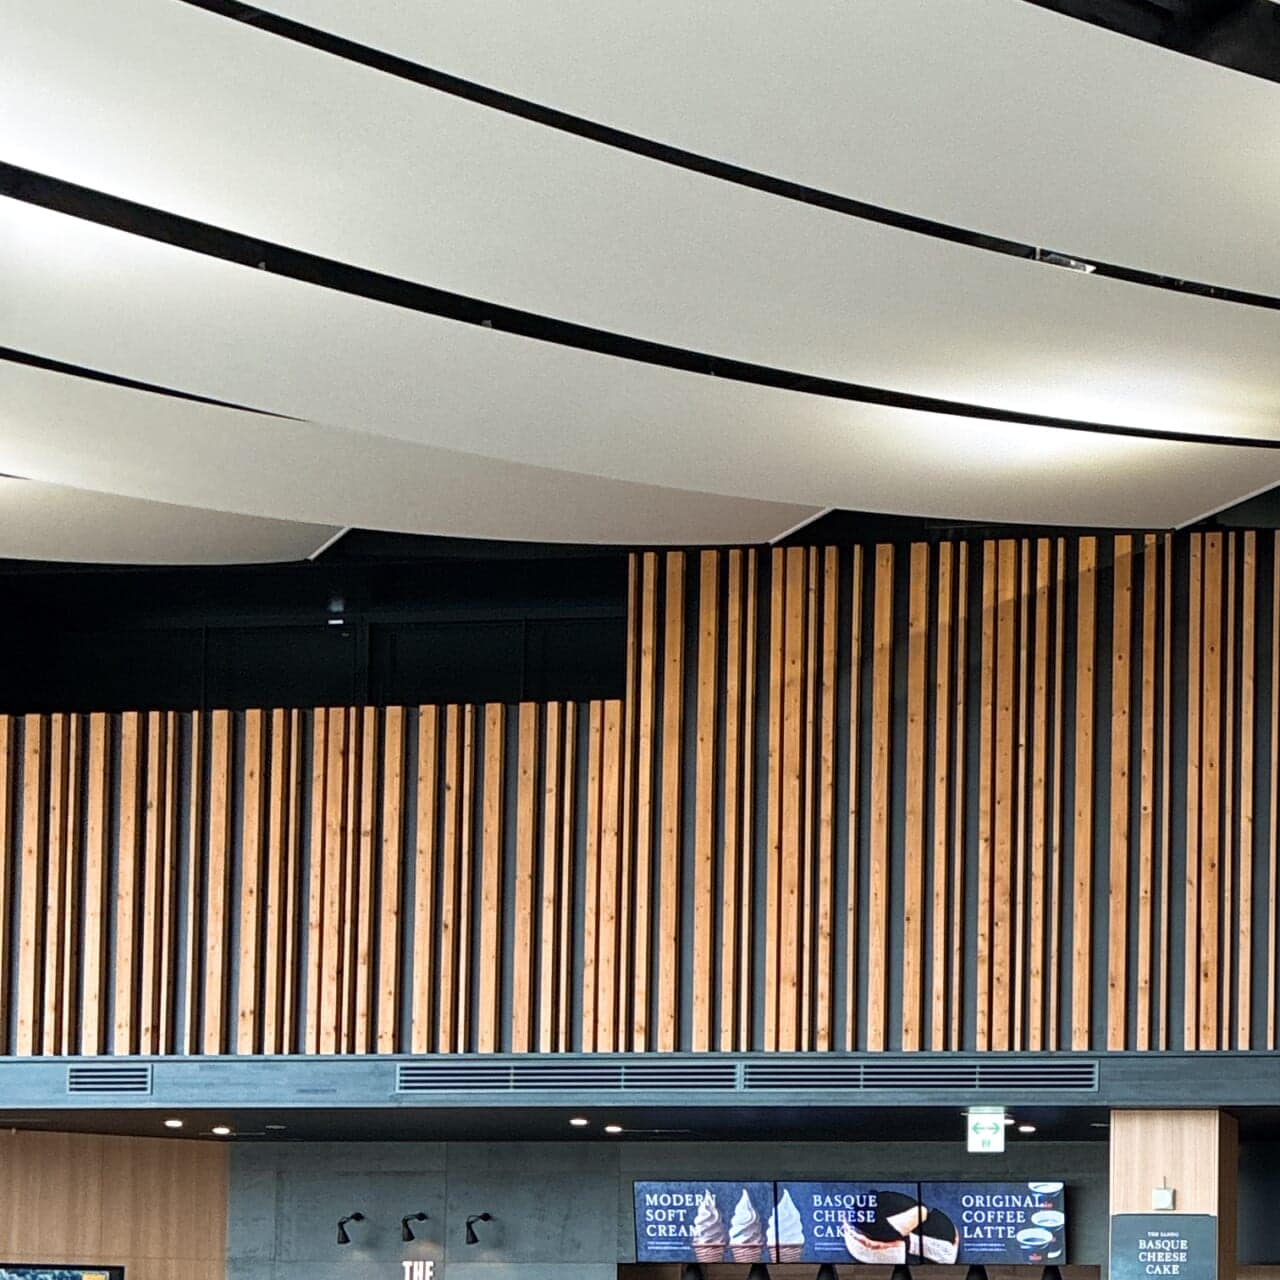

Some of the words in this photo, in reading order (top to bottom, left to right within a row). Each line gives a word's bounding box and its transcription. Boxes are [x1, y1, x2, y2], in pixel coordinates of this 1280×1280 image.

[645, 1193, 717, 1207] MODERN
[812, 1194, 878, 1210] BASQUE
[961, 1195, 1043, 1208] ORIGINAL
[645, 1209, 687, 1222] SOFT
[812, 1210, 876, 1223] CHEESE
[962, 1210, 1026, 1223] COFFEE
[646, 1224, 702, 1238] CREAM
[963, 1226, 1017, 1239] LATTE
[1138, 1239, 1188, 1251] BASQUE
[1138, 1252, 1188, 1262] CHEESE
[1146, 1264, 1180, 1275] CAKE
